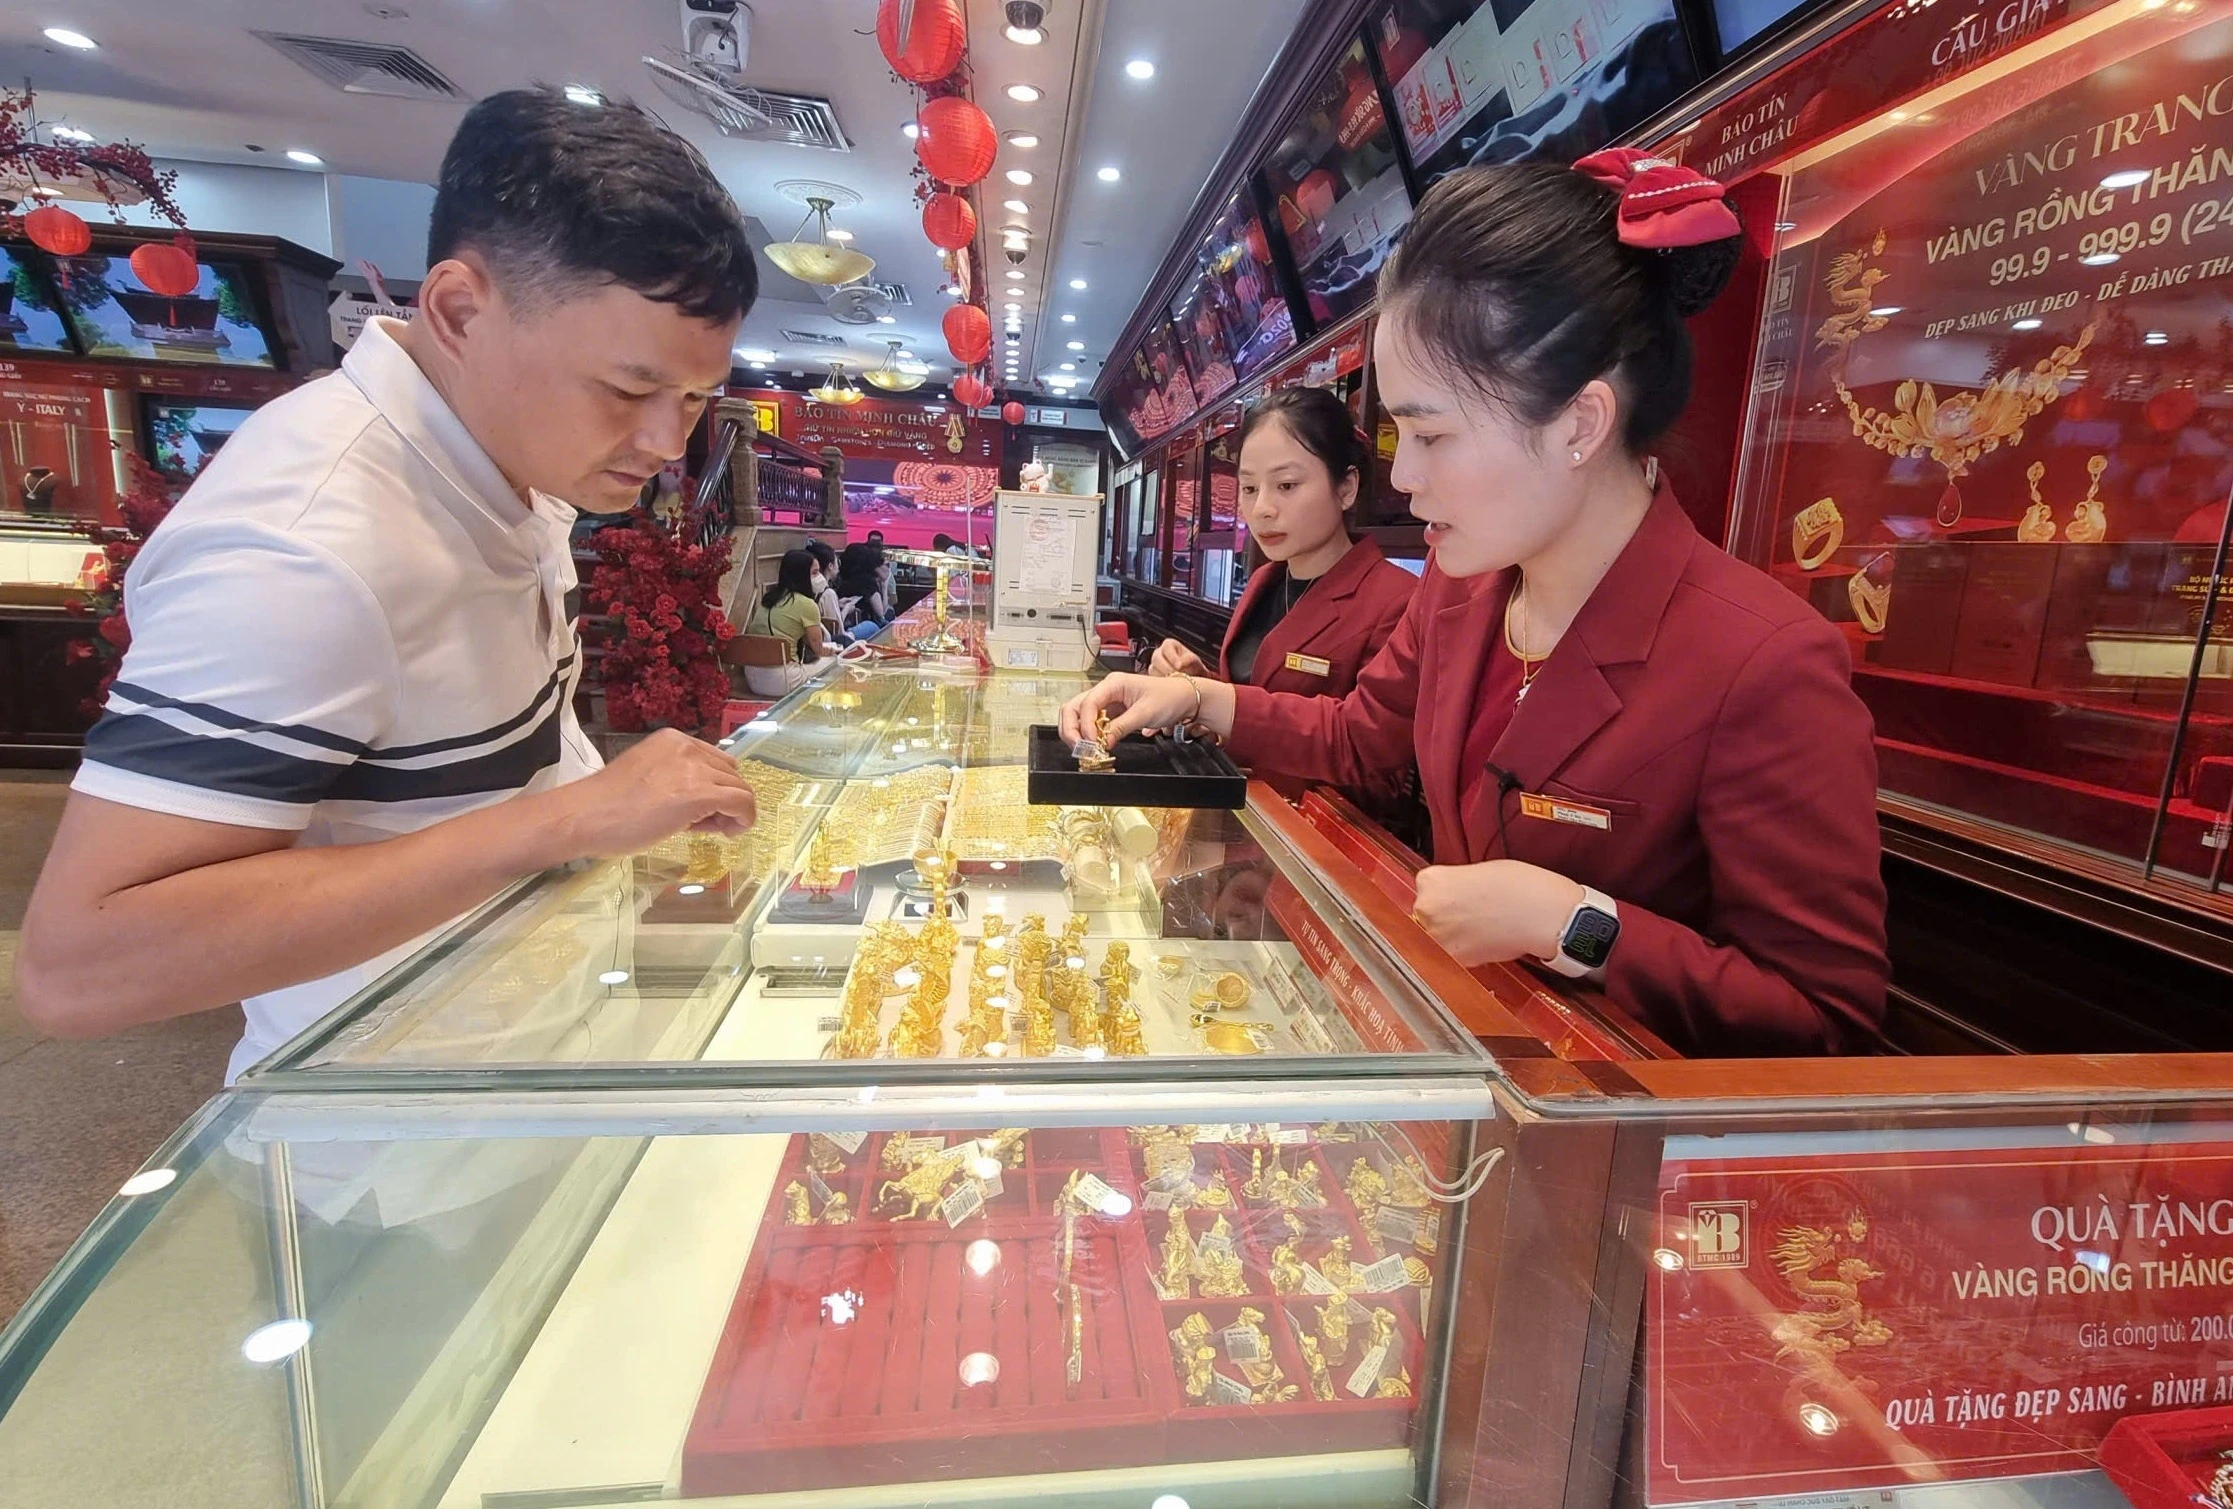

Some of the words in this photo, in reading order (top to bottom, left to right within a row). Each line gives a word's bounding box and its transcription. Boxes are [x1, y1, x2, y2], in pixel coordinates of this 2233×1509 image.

[1705, 143, 1746, 176] MINH
[1749, 115, 1799, 155] CHÂU
[1721, 114, 1754, 145] BẢO
[1758, 92, 1787, 124] TÍN
[1975, 134, 2077, 196] VÀNG
[1925, 216, 2005, 265] VÀNG
[2013, 186, 2115, 238] RỒNG
[1989, 246, 2050, 286] 99.9
[2078, 212, 2172, 264] 999.9
[1925, 318, 1955, 339] ĐẸP
[1957, 308, 2000, 331] SANG
[2003, 299, 2036, 322] KHI
[2040, 290, 2079, 314] ĐEO
[2097, 270, 2129, 301] DỄ
[2129, 264, 2192, 295] DÀNG
[36, 403, 65, 416] ITALY
[2031, 1193, 2119, 1251] QUÀ
[2129, 1194, 2233, 1248] TẶNG
[1952, 1262, 2038, 1299] VÀNG
[2139, 1252, 2233, 1289] THĂNG
[2079, 1320, 2108, 1348] Giá
[2113, 1320, 2157, 1351] công
[2162, 1317, 2186, 1343] từ:
[1885, 1389, 1936, 1431] QUÀ
[1945, 1389, 2006, 1429] TẶNG
[2015, 1388, 2060, 1423] ĐẸP
[2067, 1384, 2128, 1413] SANG
[2152, 1372, 2207, 1406] BÌNH
